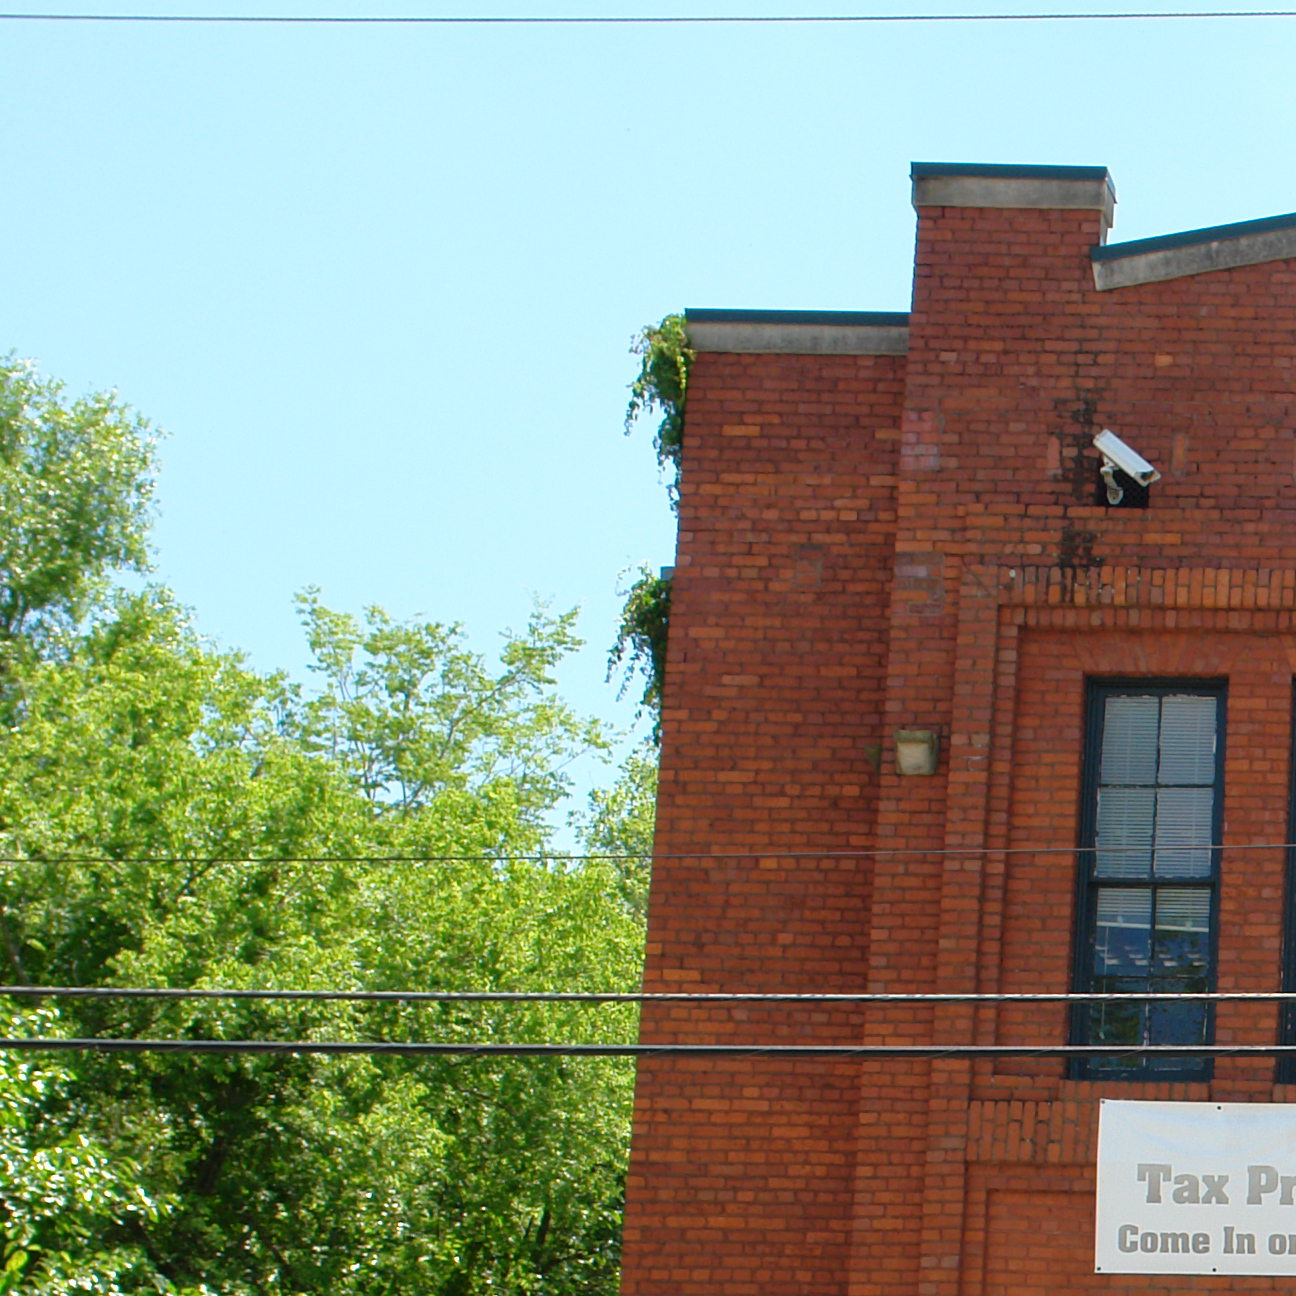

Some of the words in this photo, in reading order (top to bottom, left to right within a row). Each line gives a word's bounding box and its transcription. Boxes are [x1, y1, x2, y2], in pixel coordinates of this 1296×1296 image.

[1137, 1163, 1230, 1205] Tax
[1118, 1224, 1210, 1254] Come
[1223, 1226, 1256, 1255] In
